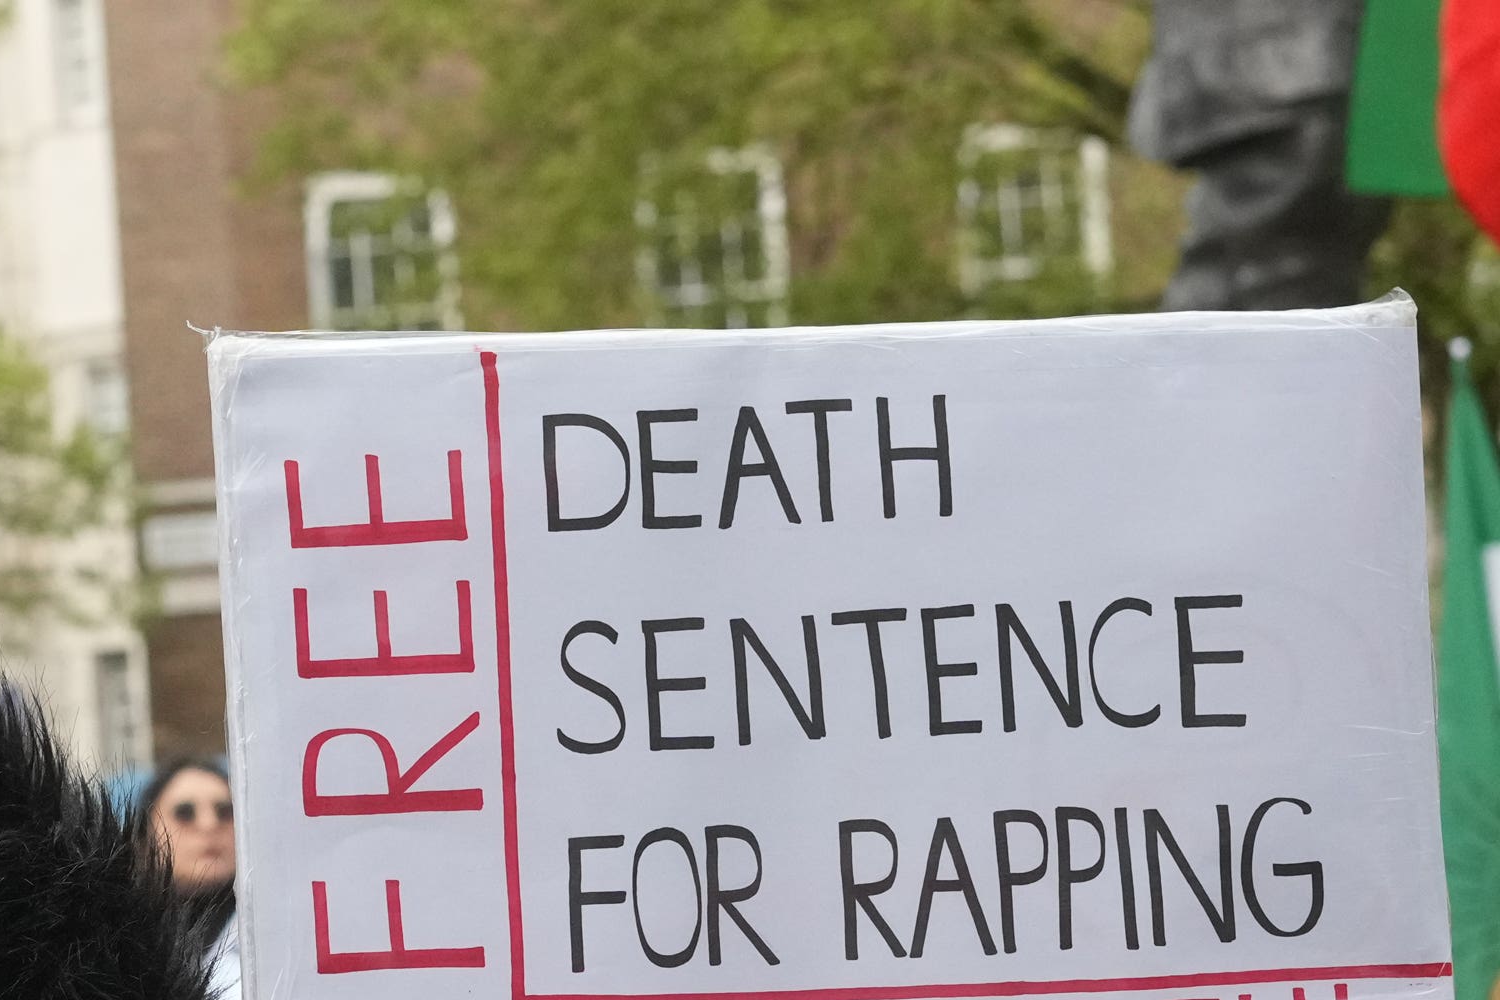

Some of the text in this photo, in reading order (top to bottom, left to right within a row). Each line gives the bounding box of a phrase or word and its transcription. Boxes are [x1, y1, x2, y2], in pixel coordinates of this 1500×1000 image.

[542, 394, 953, 533] DEATH
[284, 449, 486, 975] FREE
[556, 594, 1247, 755] SENTENCE
[567, 797, 1325, 974] FOR RAPPING
